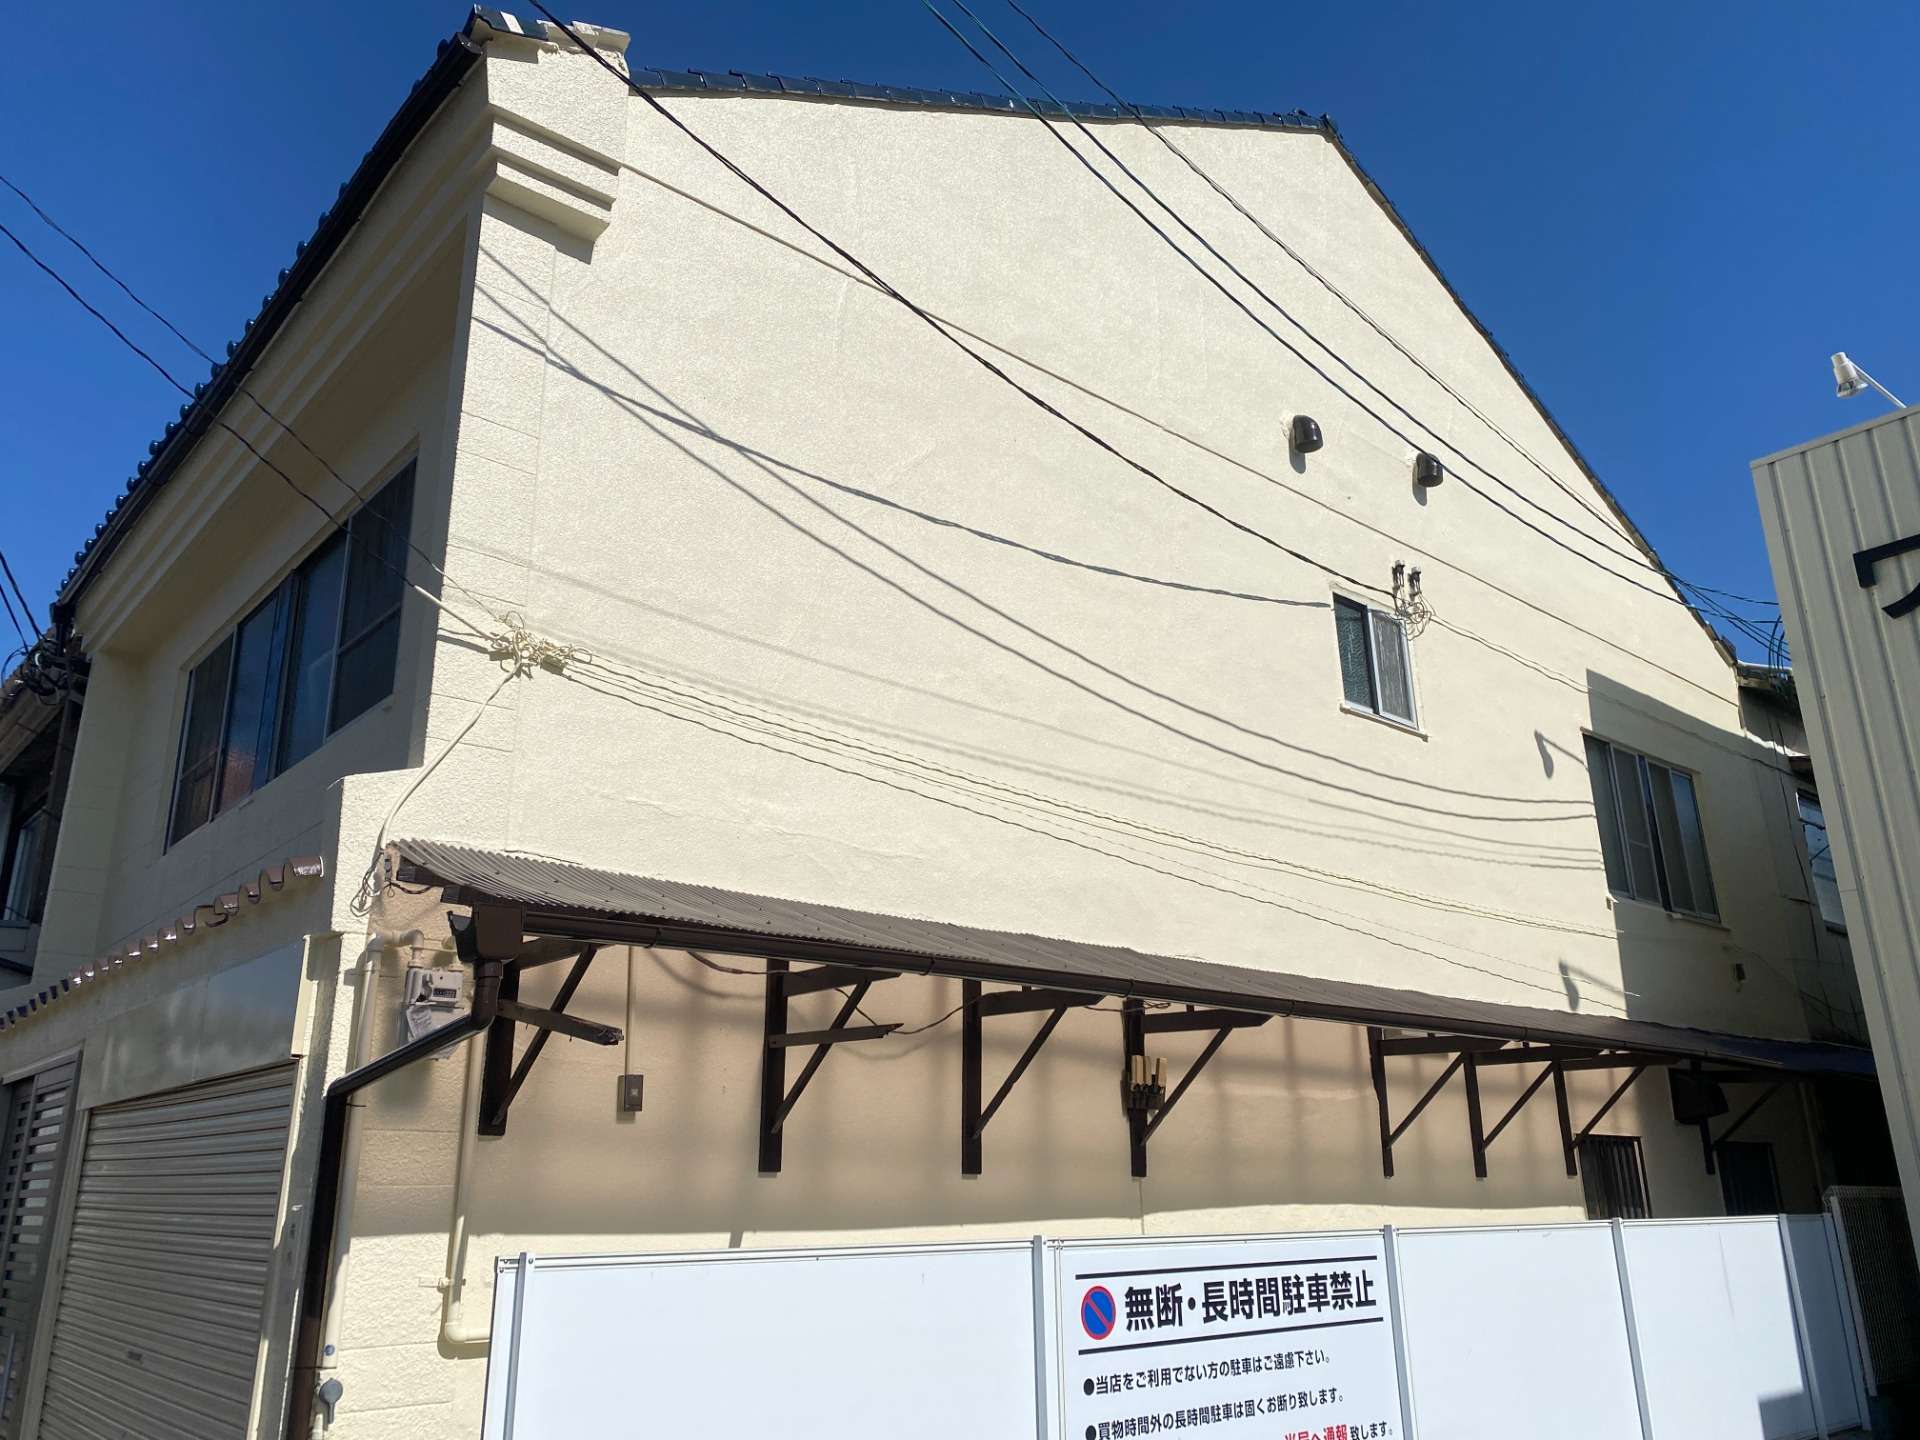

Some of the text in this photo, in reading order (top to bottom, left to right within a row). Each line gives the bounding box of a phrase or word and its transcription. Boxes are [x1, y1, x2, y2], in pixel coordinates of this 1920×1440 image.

[1125, 1270, 1377, 1332] 無断・長時間駐車禁止
